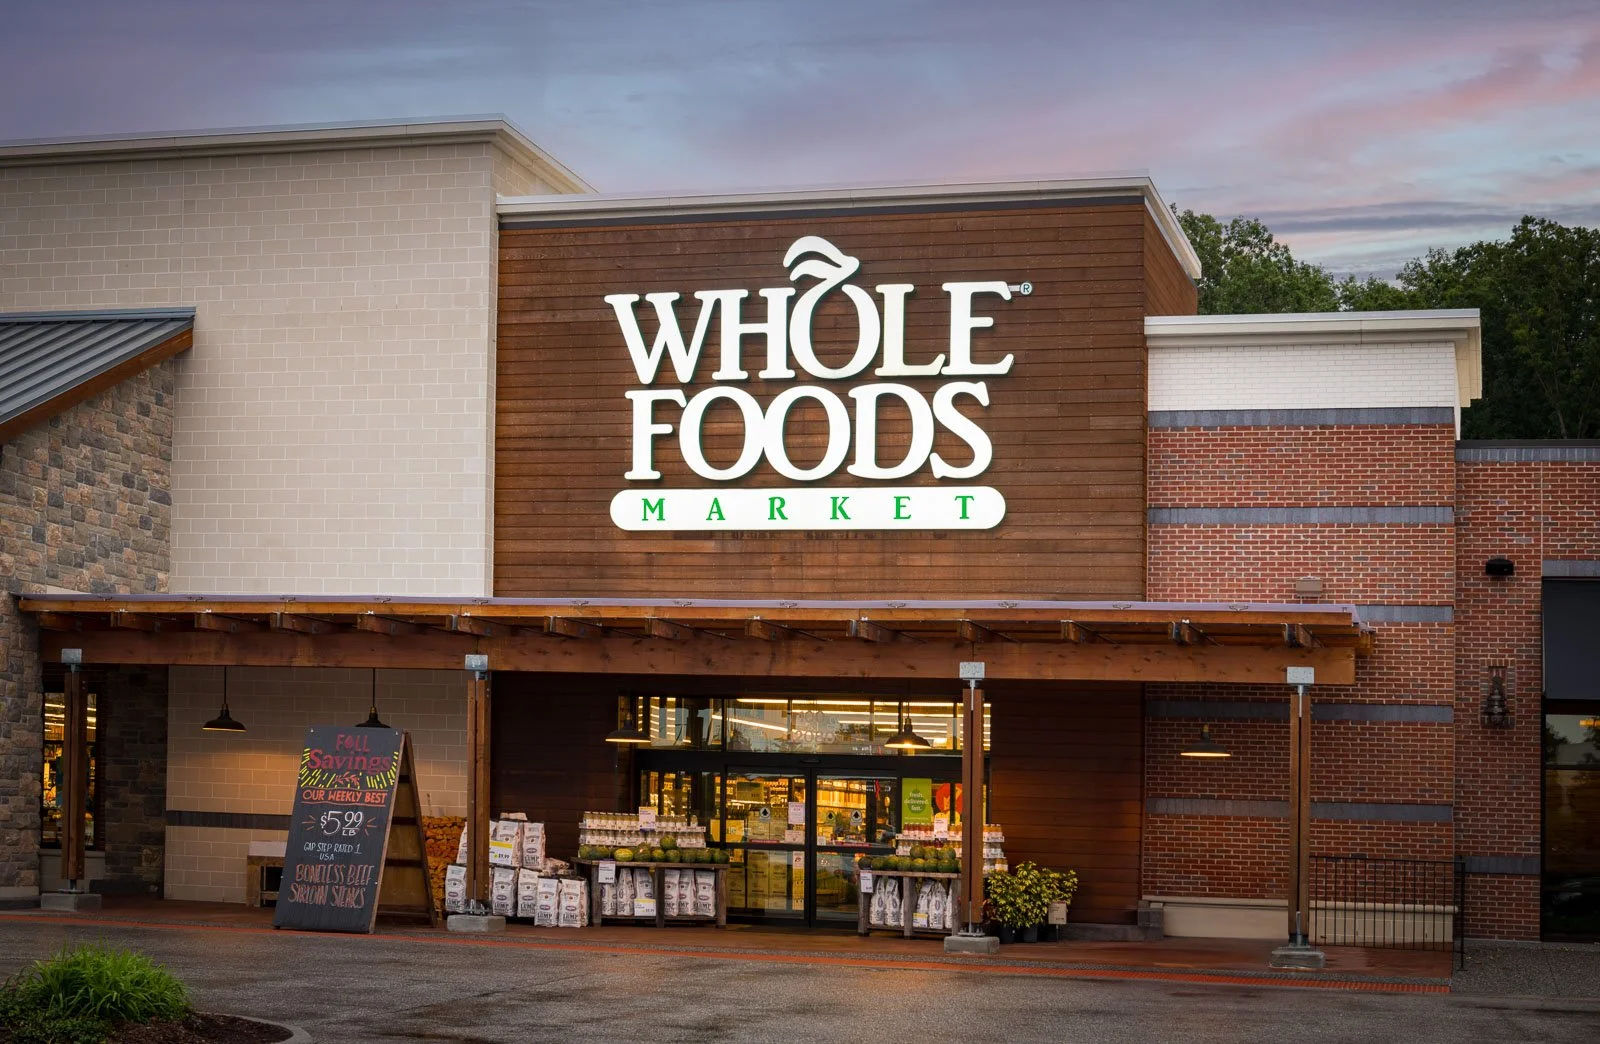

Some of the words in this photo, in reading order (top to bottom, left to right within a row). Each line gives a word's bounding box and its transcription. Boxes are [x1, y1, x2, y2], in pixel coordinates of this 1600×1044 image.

[604, 236, 1014, 385] WHOLE
[624, 381, 993, 481] FOODS
[642, 495, 975, 521] MARKET
[308, 749, 392, 775] Savings
[302, 789, 326, 801] OUR
[328, 790, 362, 803] WEEKLY
[364, 792, 388, 805] BEST
[317, 842, 333, 852] STEP
[295, 863, 346, 885] BONELESS
[347, 864, 374, 886] BEEF
[330, 884, 366, 909] STEAKS
